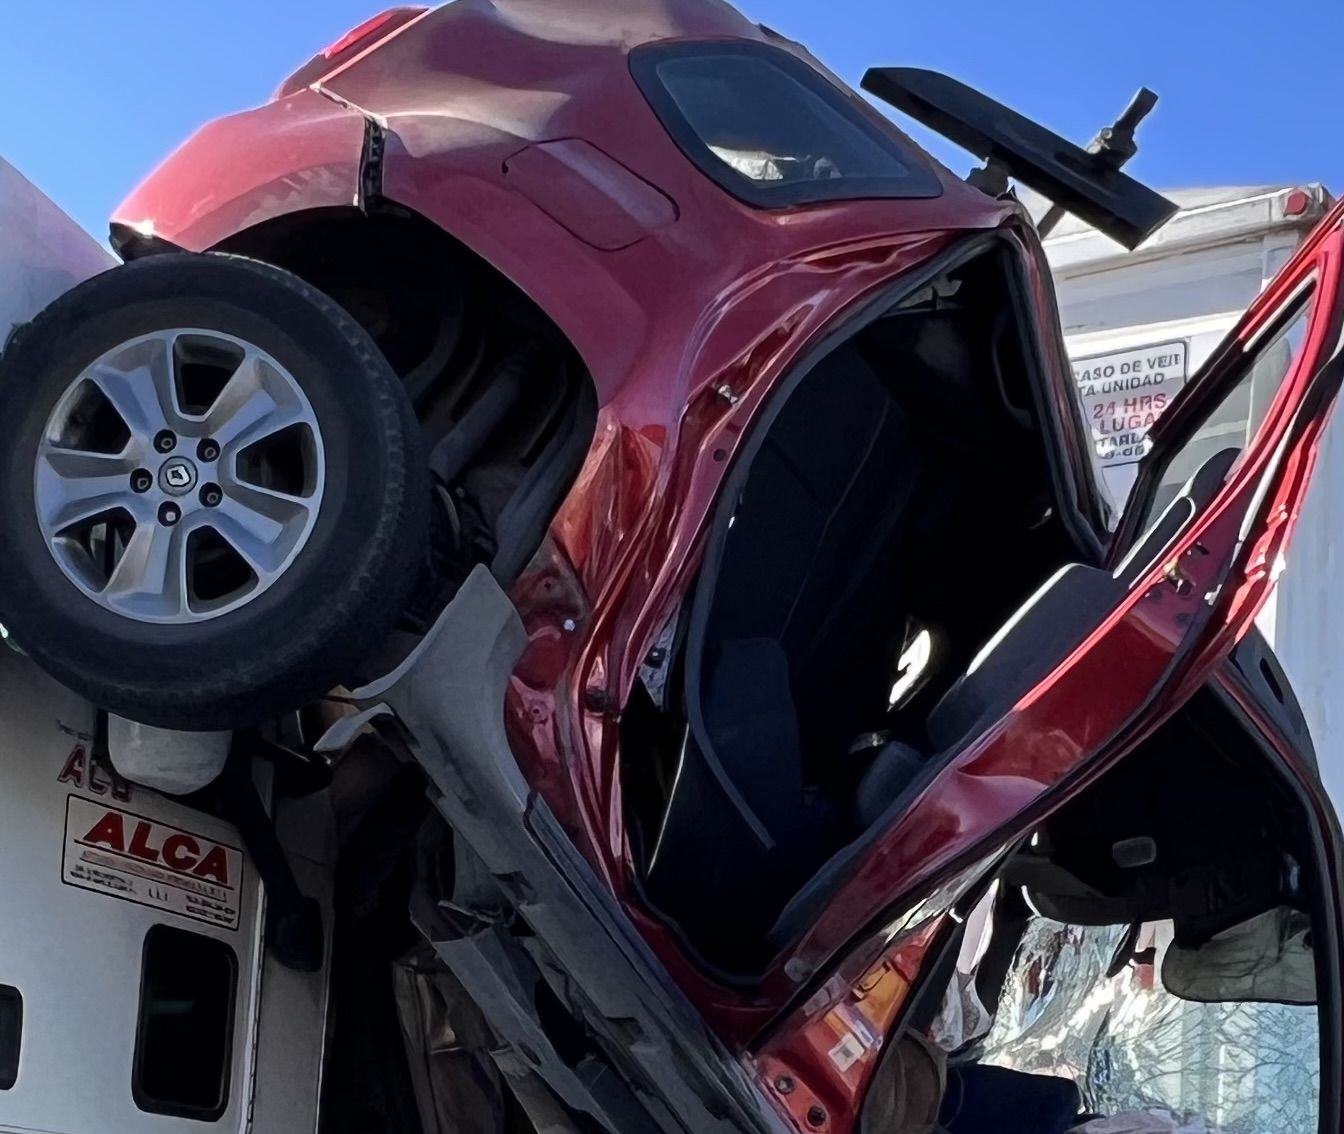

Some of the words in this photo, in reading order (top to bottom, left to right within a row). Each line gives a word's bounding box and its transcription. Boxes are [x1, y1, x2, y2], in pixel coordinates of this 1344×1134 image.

[1120, 361, 1142, 375] DE
[1102, 373, 1165, 394] UNIDAD
[82, 811, 228, 886] ALCA
